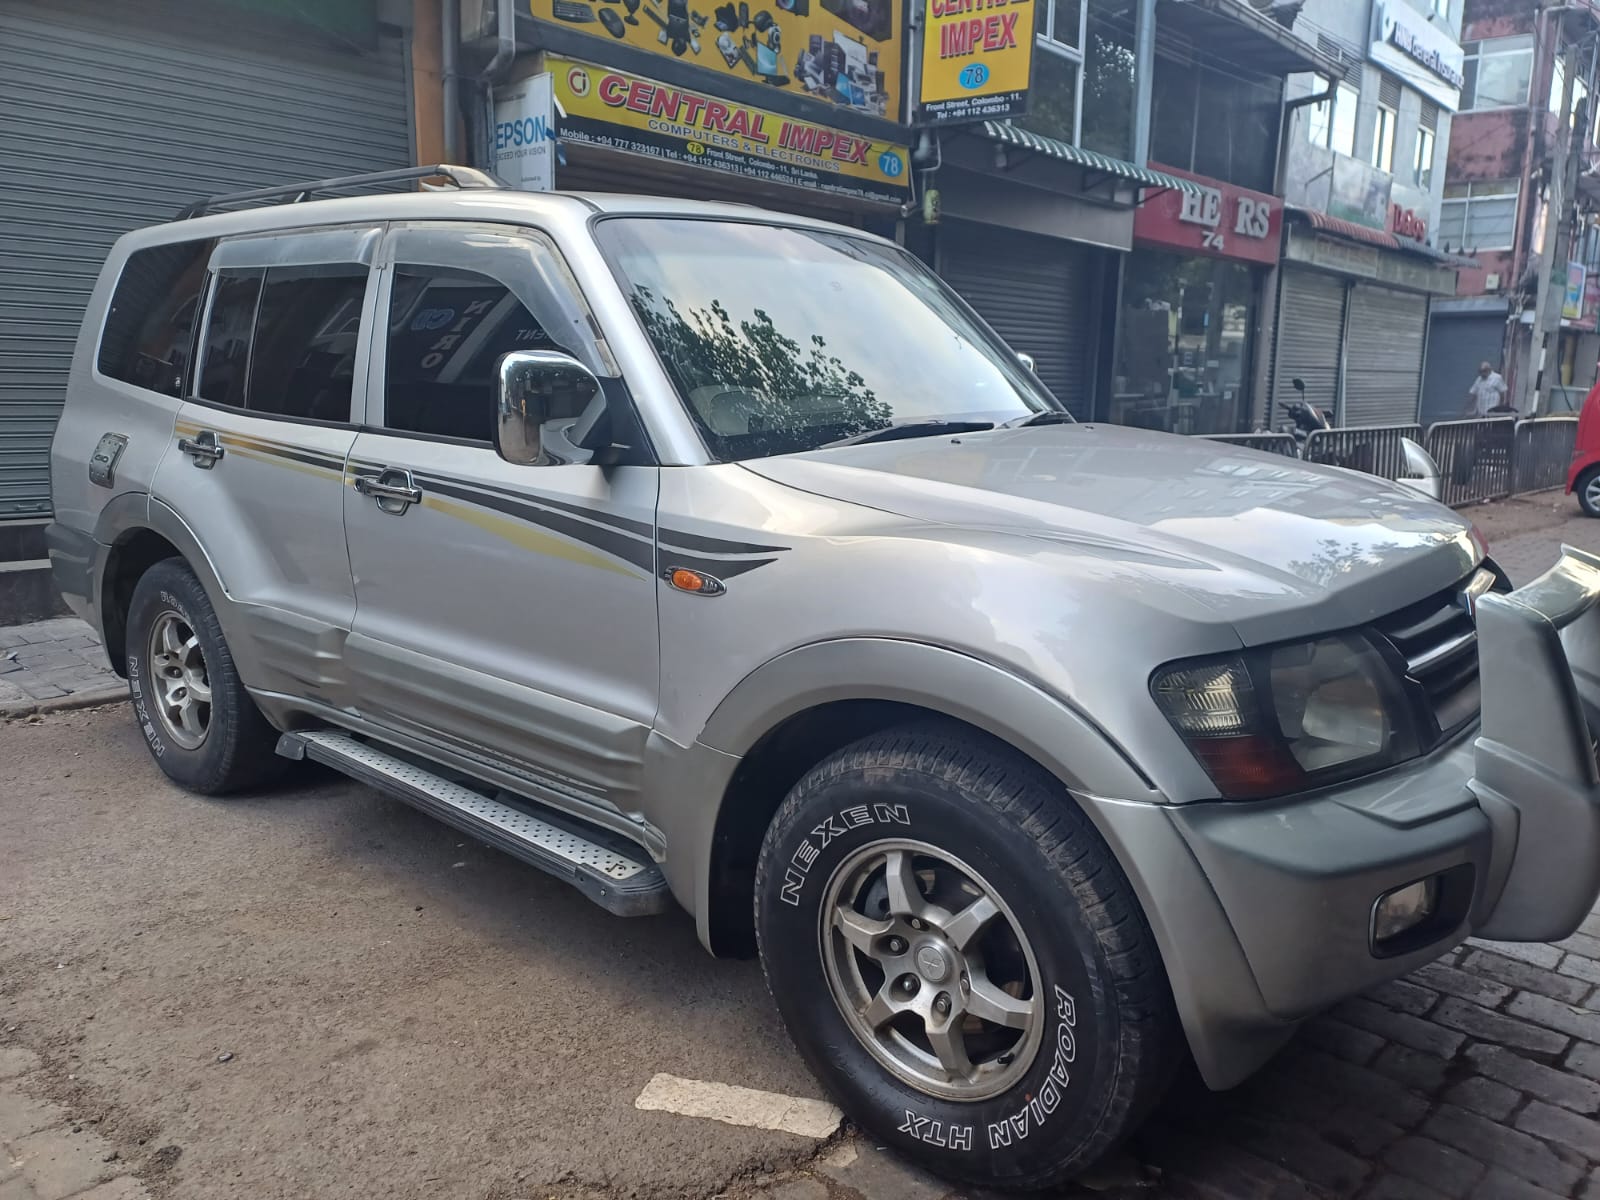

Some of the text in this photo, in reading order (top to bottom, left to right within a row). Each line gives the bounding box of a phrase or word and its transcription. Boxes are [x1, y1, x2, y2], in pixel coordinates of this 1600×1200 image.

[940, 12, 1019, 59] IMPEX
[965, 66, 984, 85] 78
[598, 73, 872, 166] CENTRAL IMPEX
[937, 110, 947, 119] Tel
[495, 115, 545, 149] EPSON
[560, 128, 591, 141] Mobile
[665, 148, 678, 159] Tel
[648, 119, 840, 171] COMPUTERS & ELECTRONICS
[514, 147, 528, 159] YOUR
[528, 145, 546, 156] VISION
[690, 143, 701, 154] 78
[884, 154, 899, 175] 78
[1201, 231, 1225, 251] 74
[127, 655, 166, 758] NEXEN
[780, 803, 911, 906] NEXEN
[898, 983, 1076, 1151] ROADIAN HTX
